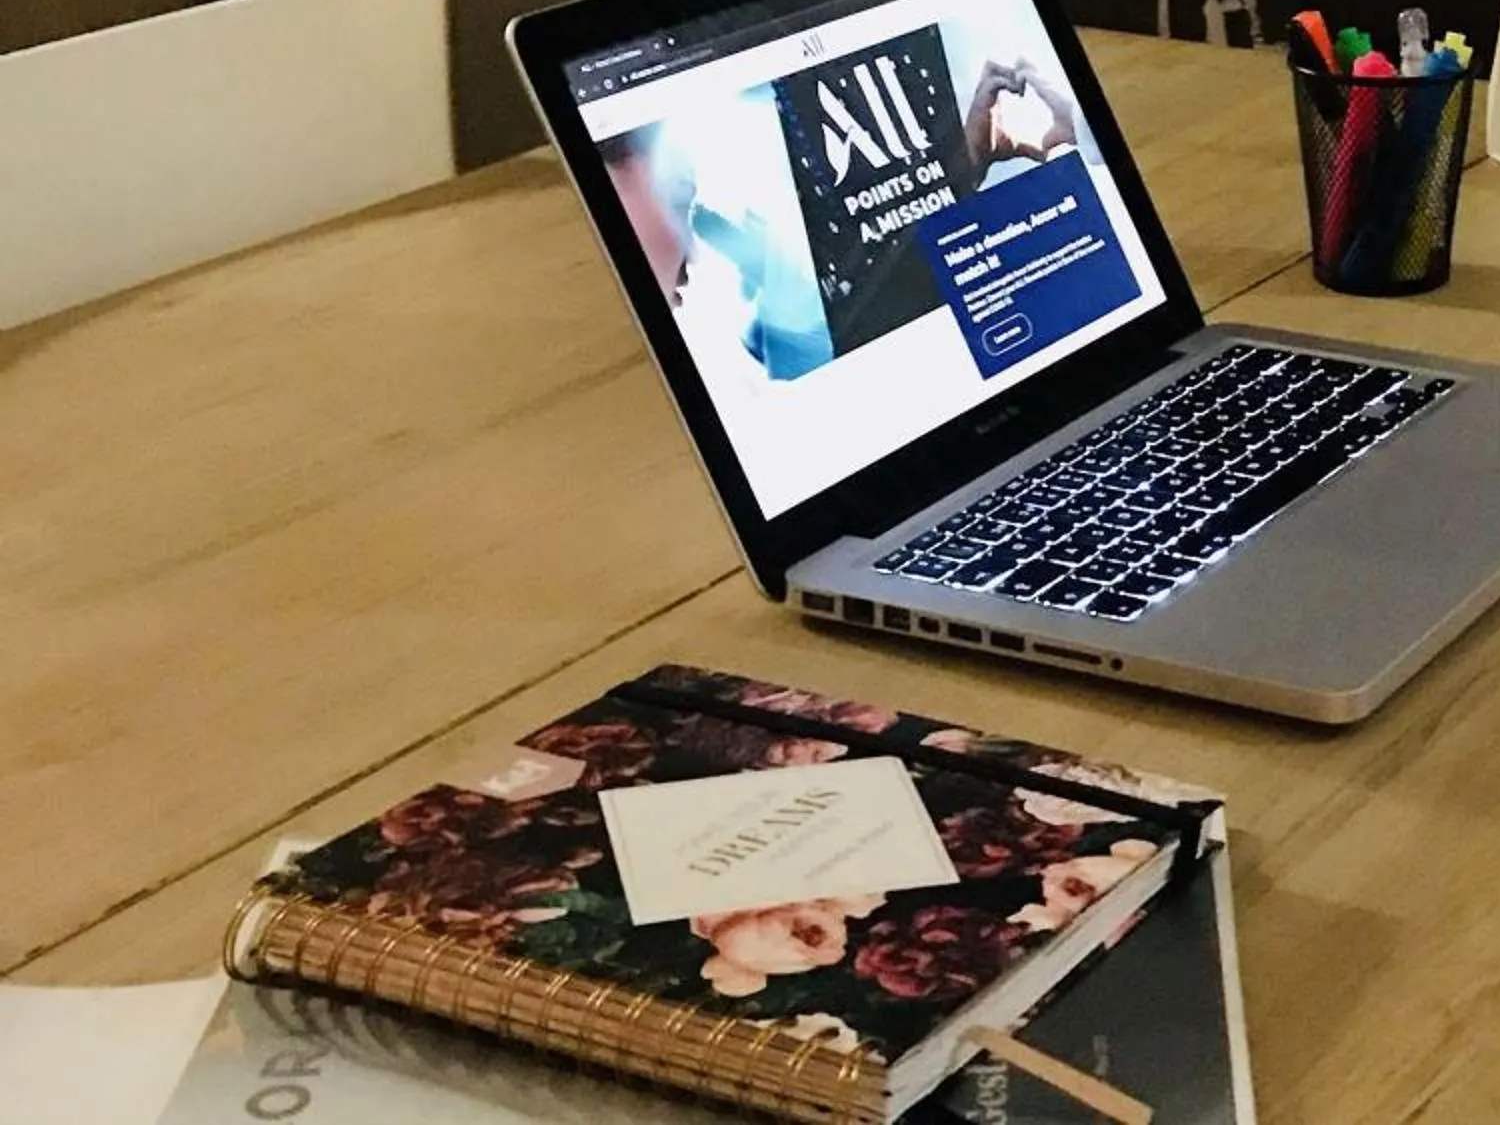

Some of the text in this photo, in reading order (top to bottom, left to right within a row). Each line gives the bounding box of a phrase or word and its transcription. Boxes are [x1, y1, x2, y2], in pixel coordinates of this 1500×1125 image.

[843, 160, 945, 216] POINTS ON
[876, 186, 957, 235] MISSION
[688, 787, 842, 876] DREAMS
